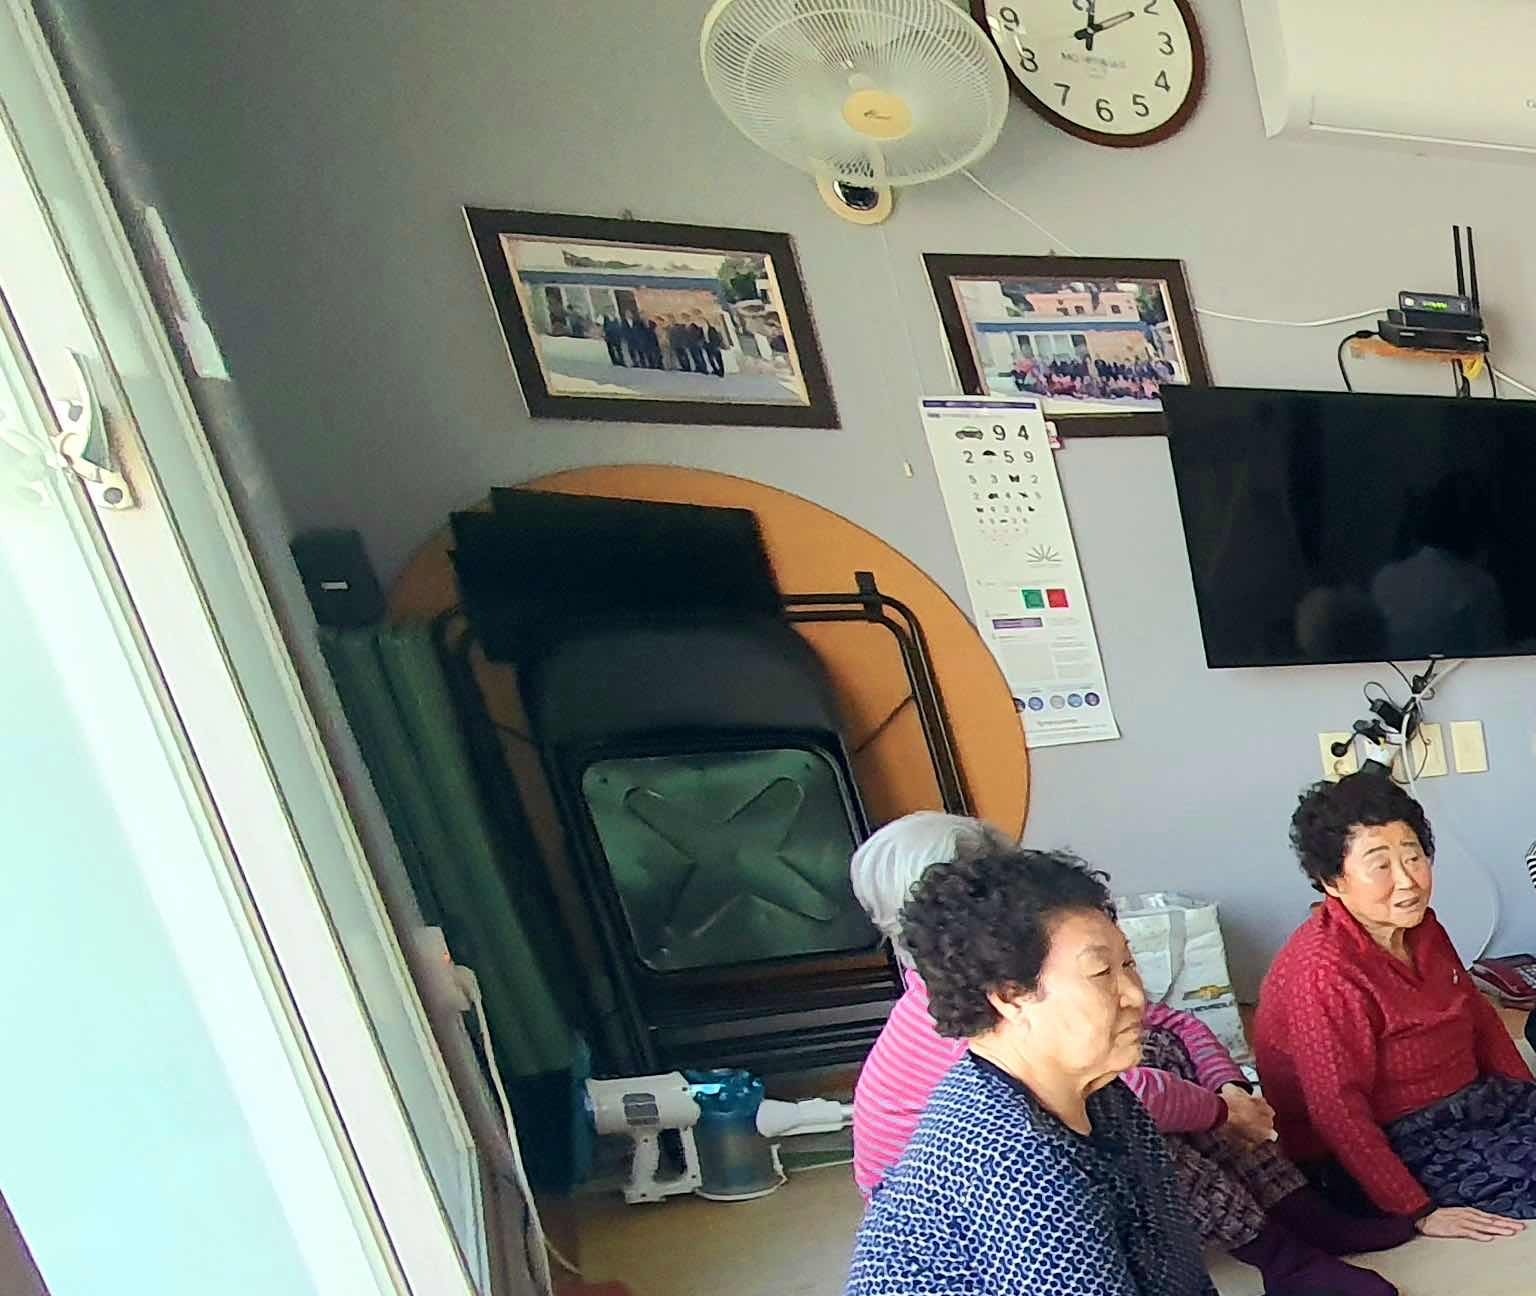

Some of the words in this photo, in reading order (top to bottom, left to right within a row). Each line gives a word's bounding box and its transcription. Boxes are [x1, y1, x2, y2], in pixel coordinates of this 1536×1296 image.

[1158, 31, 1174, 55] 3
[1020, 48, 1038, 72] 8
[1154, 70, 1171, 91] 4
[1054, 83, 1071, 106] 7
[1132, 94, 1149, 117] 5
[1096, 98, 1114, 122] 6
[993, 425, 1006, 441] 9
[1018, 425, 1030, 441] 4
[963, 451, 974, 464] 2
[1004, 451, 1015, 464] 5
[1024, 451, 1034, 464] 9
